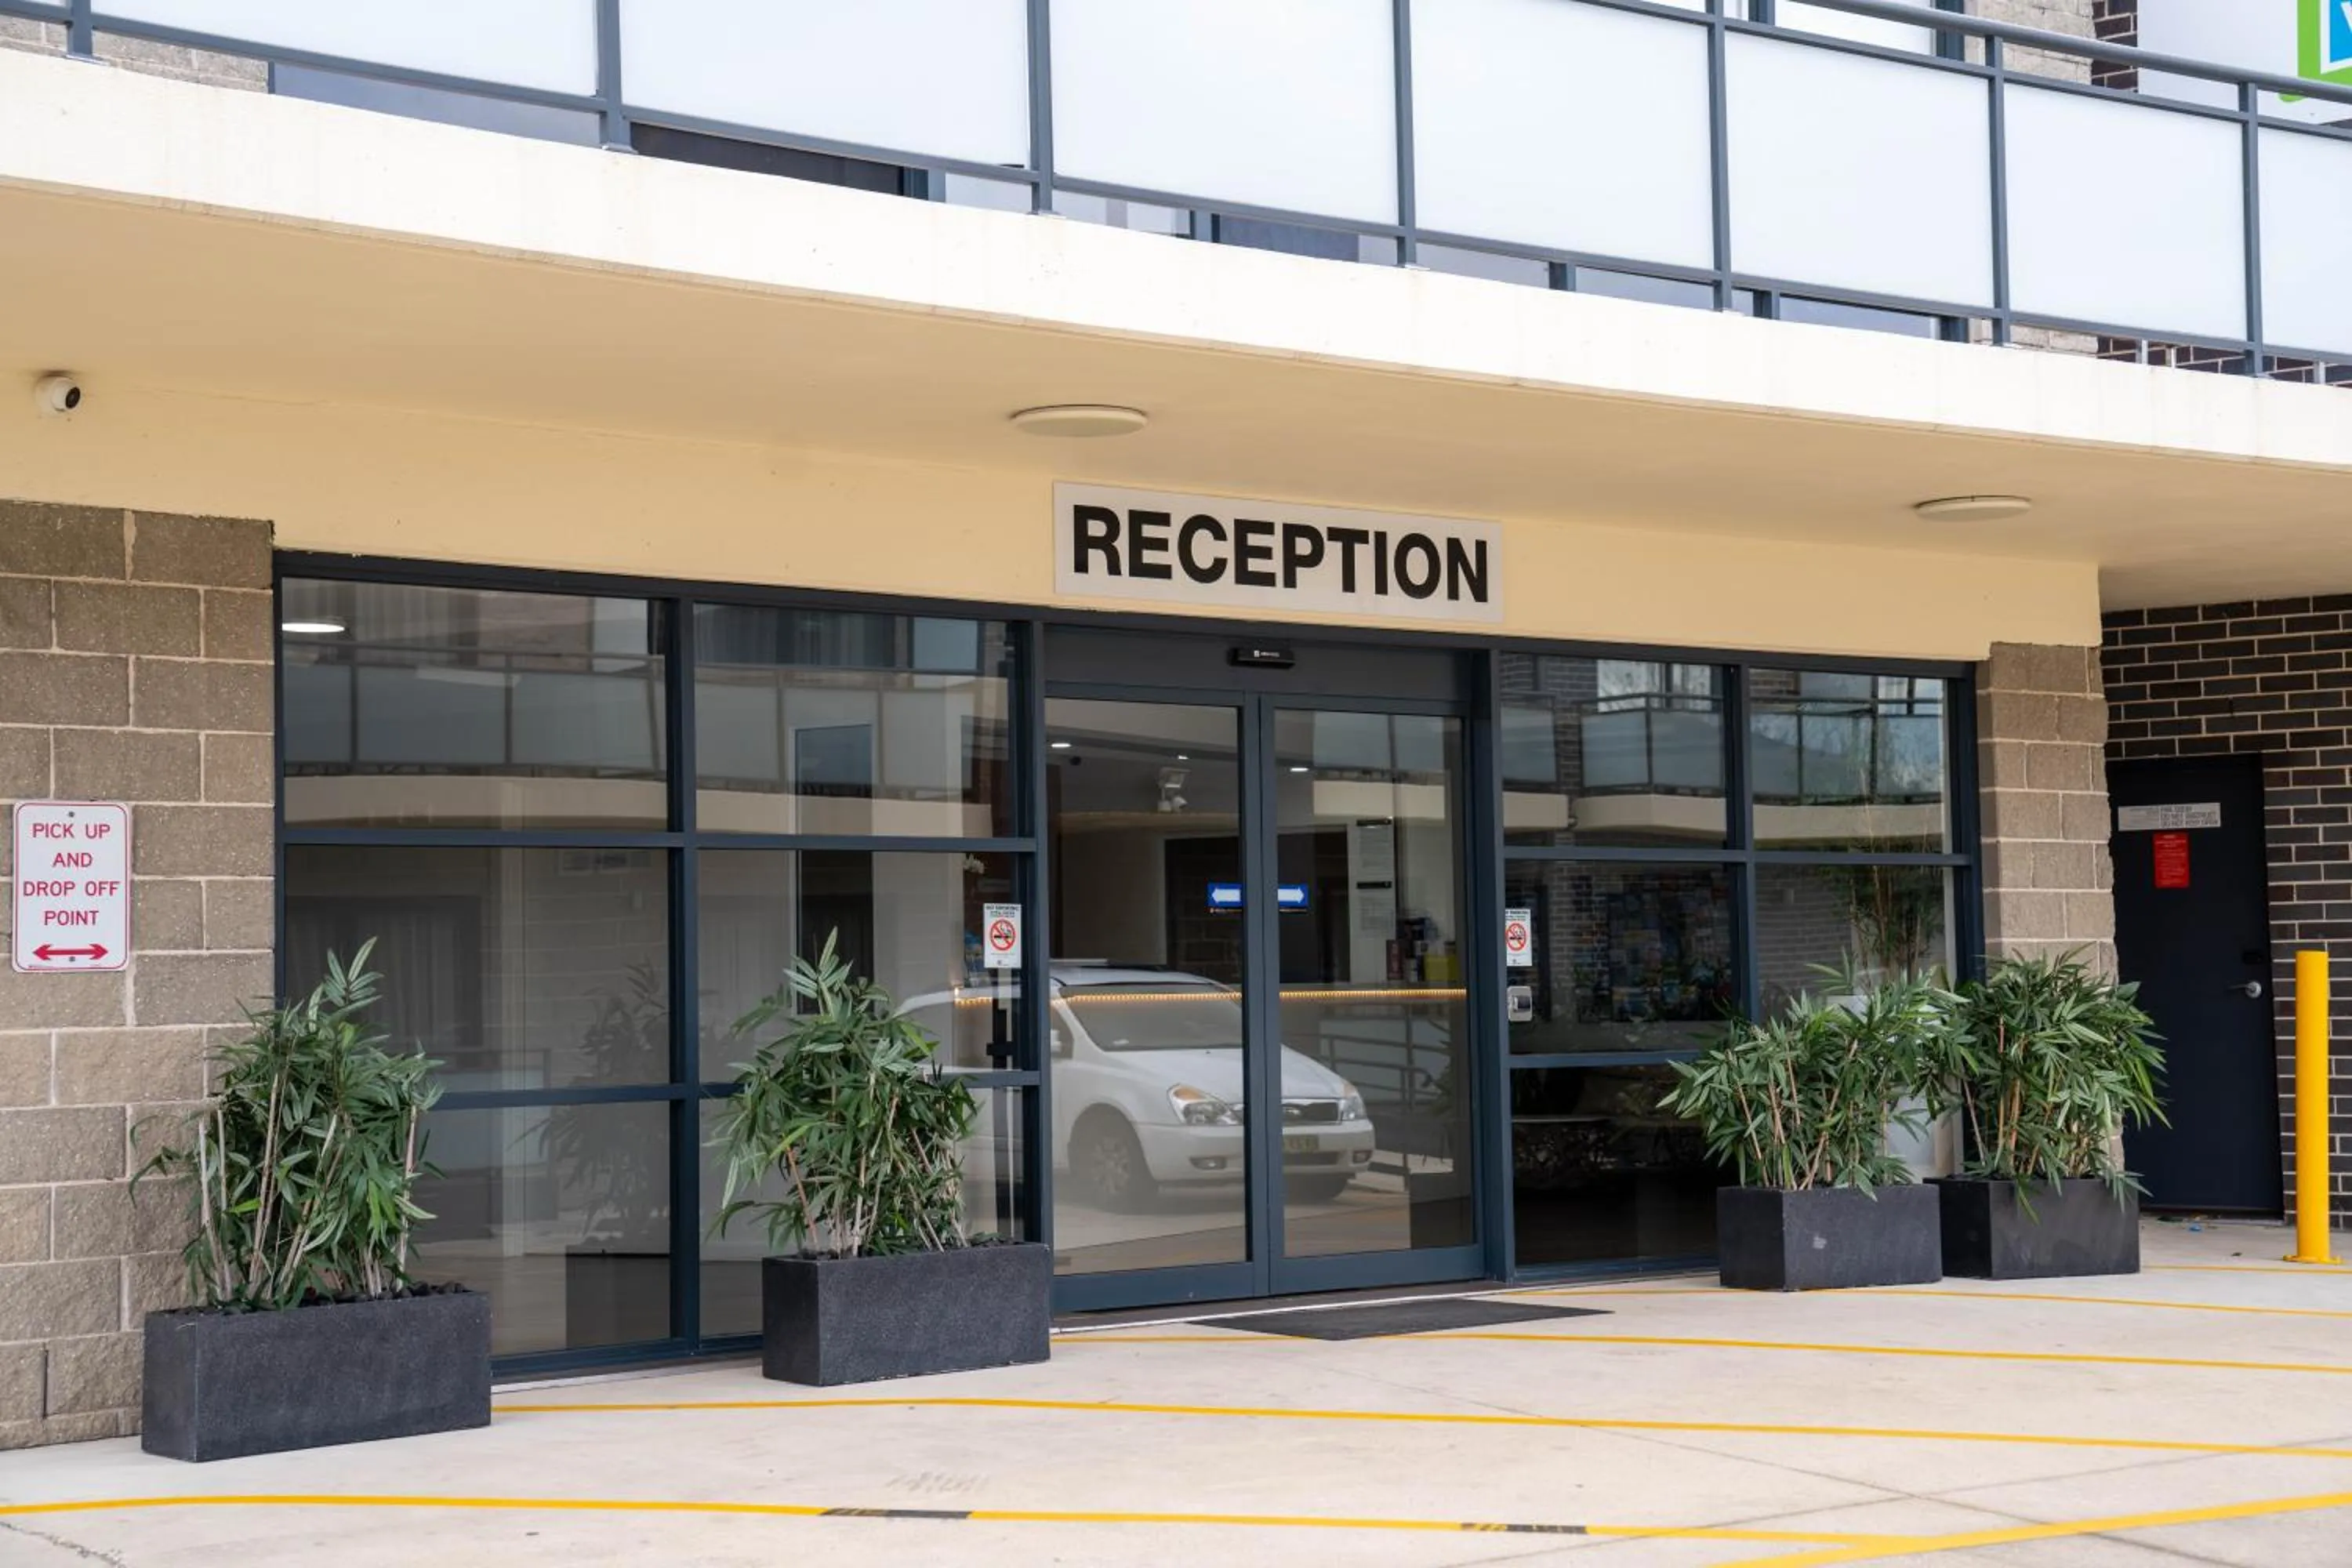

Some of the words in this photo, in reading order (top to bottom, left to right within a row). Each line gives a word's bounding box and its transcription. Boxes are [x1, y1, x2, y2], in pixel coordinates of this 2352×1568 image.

[1073, 504, 1489, 603] RECEPTION
[32, 823, 74, 839] PICK
[85, 824, 111, 839] UP
[53, 852, 93, 868] AND
[24, 880, 75, 896] DROP
[85, 880, 120, 896] OFF
[44, 910, 100, 926] POINT
